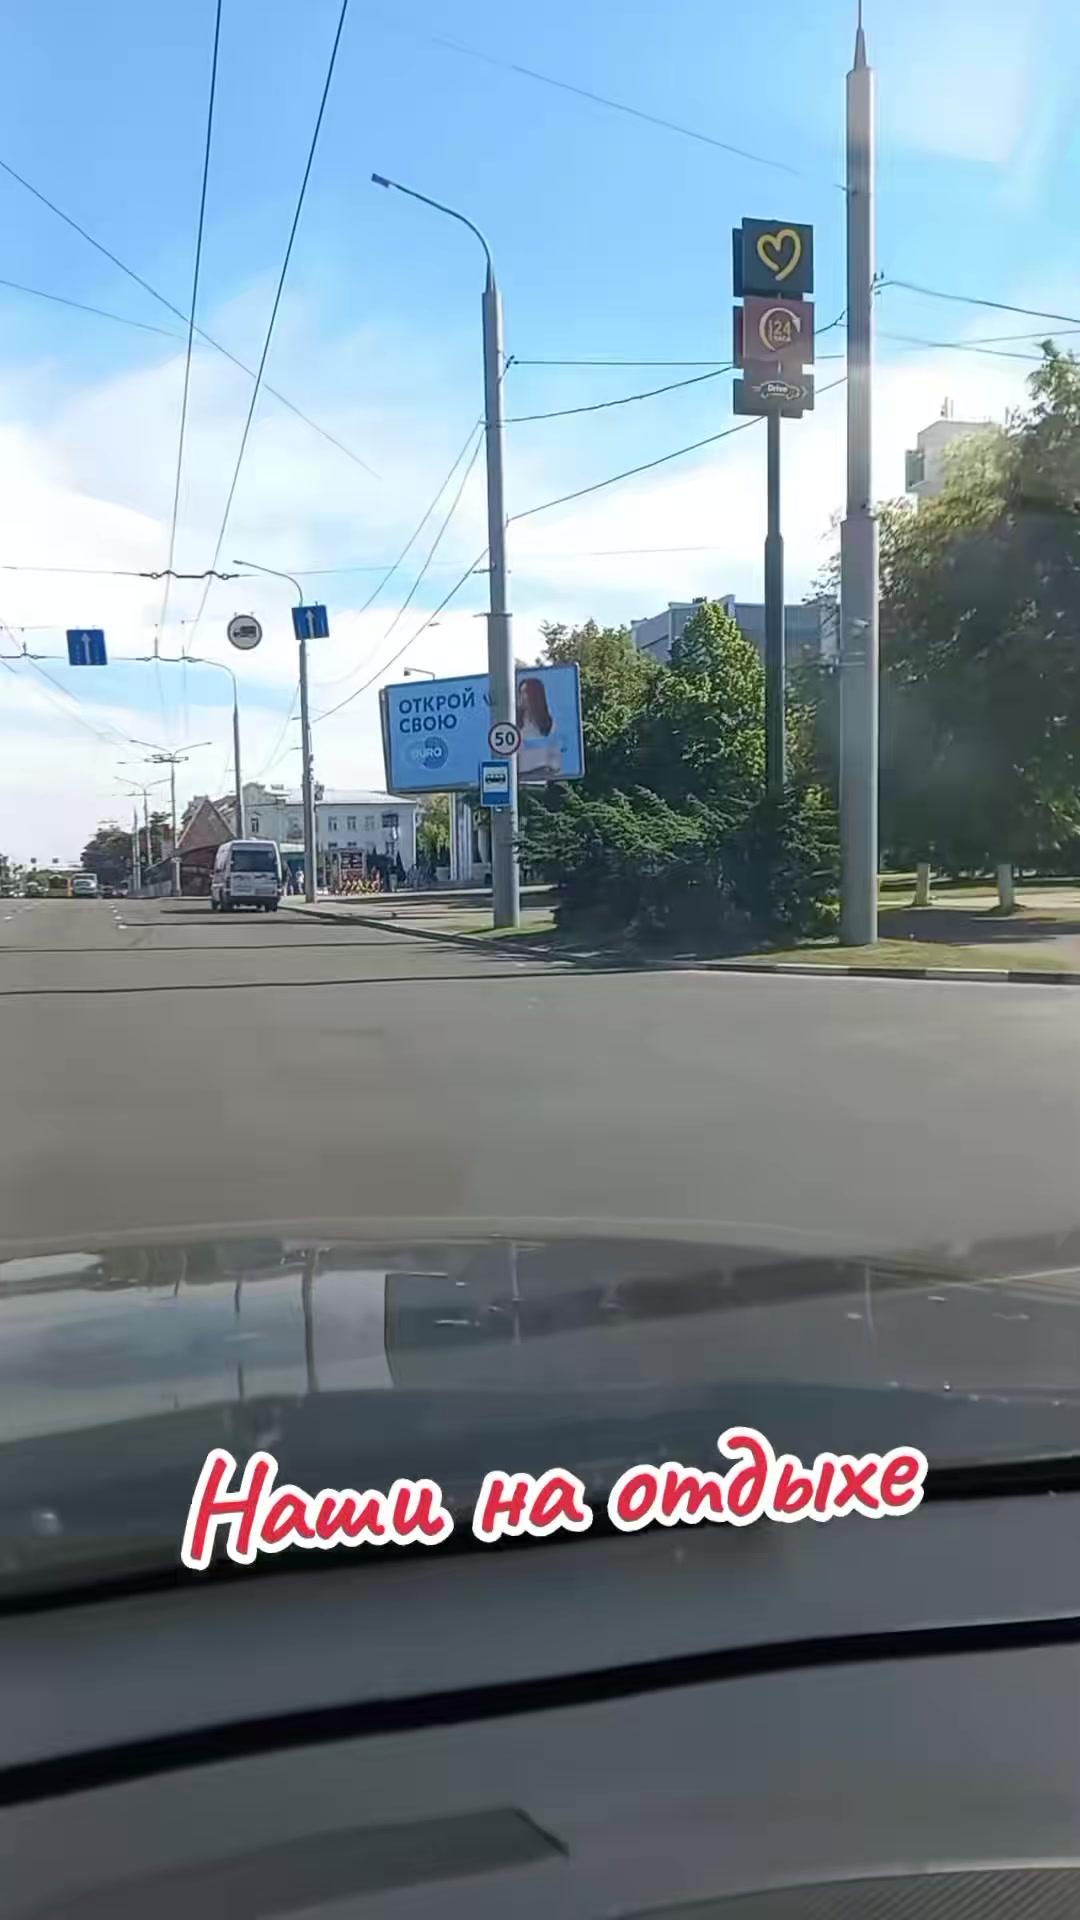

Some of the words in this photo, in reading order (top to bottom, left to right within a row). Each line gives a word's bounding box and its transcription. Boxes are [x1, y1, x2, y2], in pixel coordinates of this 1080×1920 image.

[774, 320, 791, 336] 24
[768, 384, 788, 393] Drive
[399, 688, 475, 714] ОТКРОЙ
[400, 714, 457, 733] СВОЮ
[495, 731, 515, 746] 50
